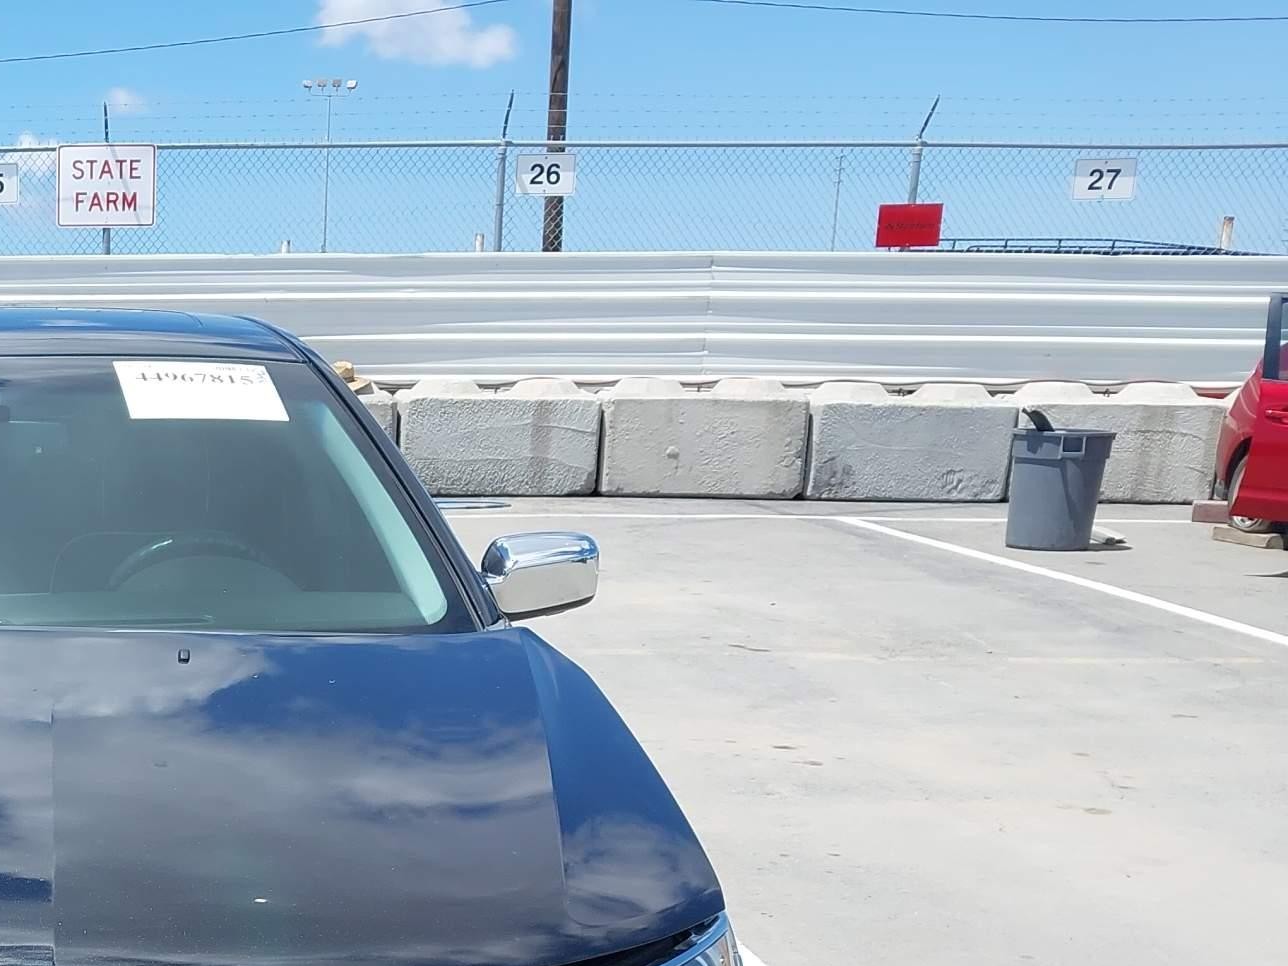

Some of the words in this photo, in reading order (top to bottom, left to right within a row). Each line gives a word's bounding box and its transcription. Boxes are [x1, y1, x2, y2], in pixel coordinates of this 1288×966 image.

[72, 160, 141, 180] STATE
[529, 163, 561, 185] 26
[1088, 168, 1121, 191] 27
[75, 192, 137, 212] FARM
